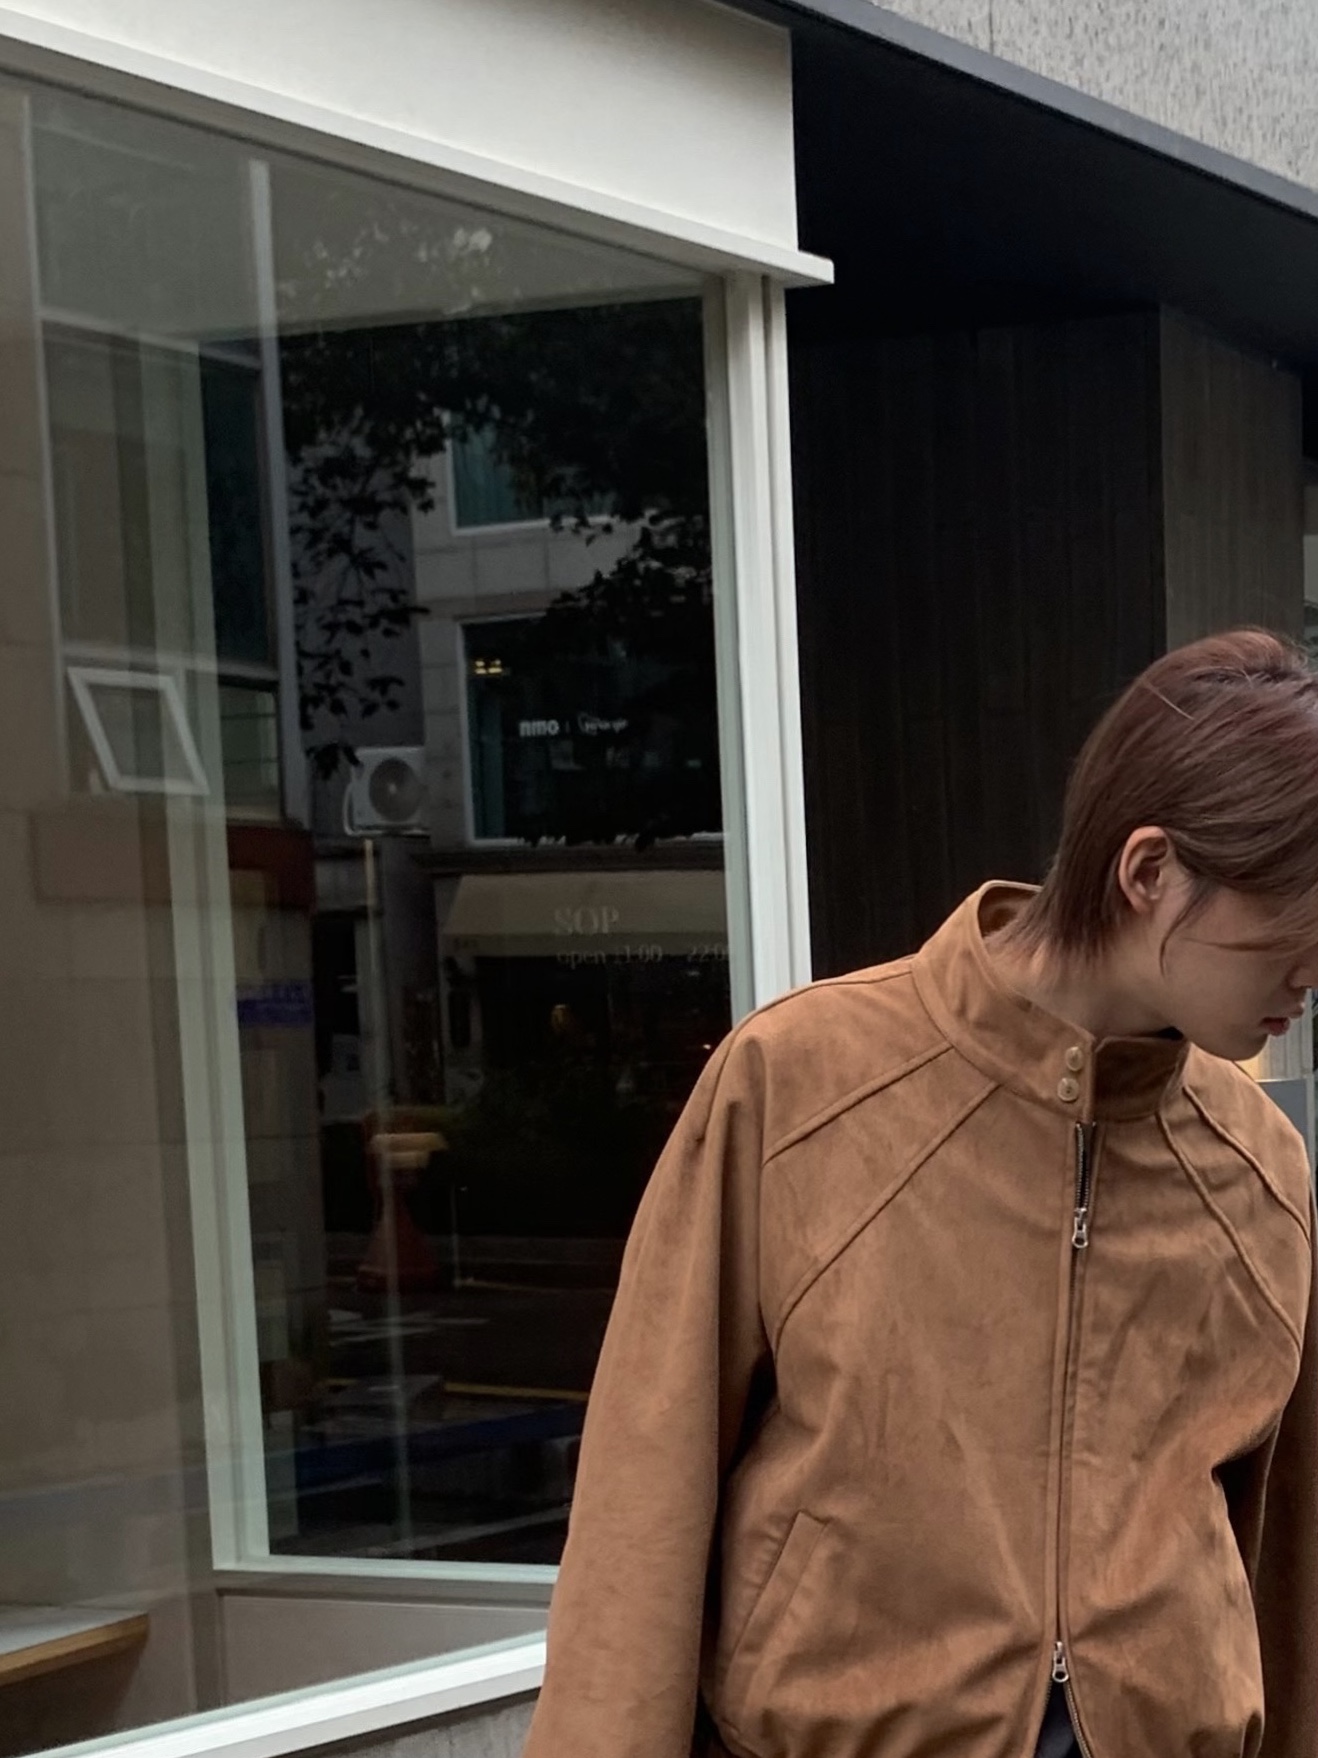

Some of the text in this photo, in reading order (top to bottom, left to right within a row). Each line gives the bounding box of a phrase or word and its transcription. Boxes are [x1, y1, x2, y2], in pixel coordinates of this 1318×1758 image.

[554, 906, 620, 935] SOP
[556, 949, 607, 970] open
[687, 943, 727, 962] 22:0
